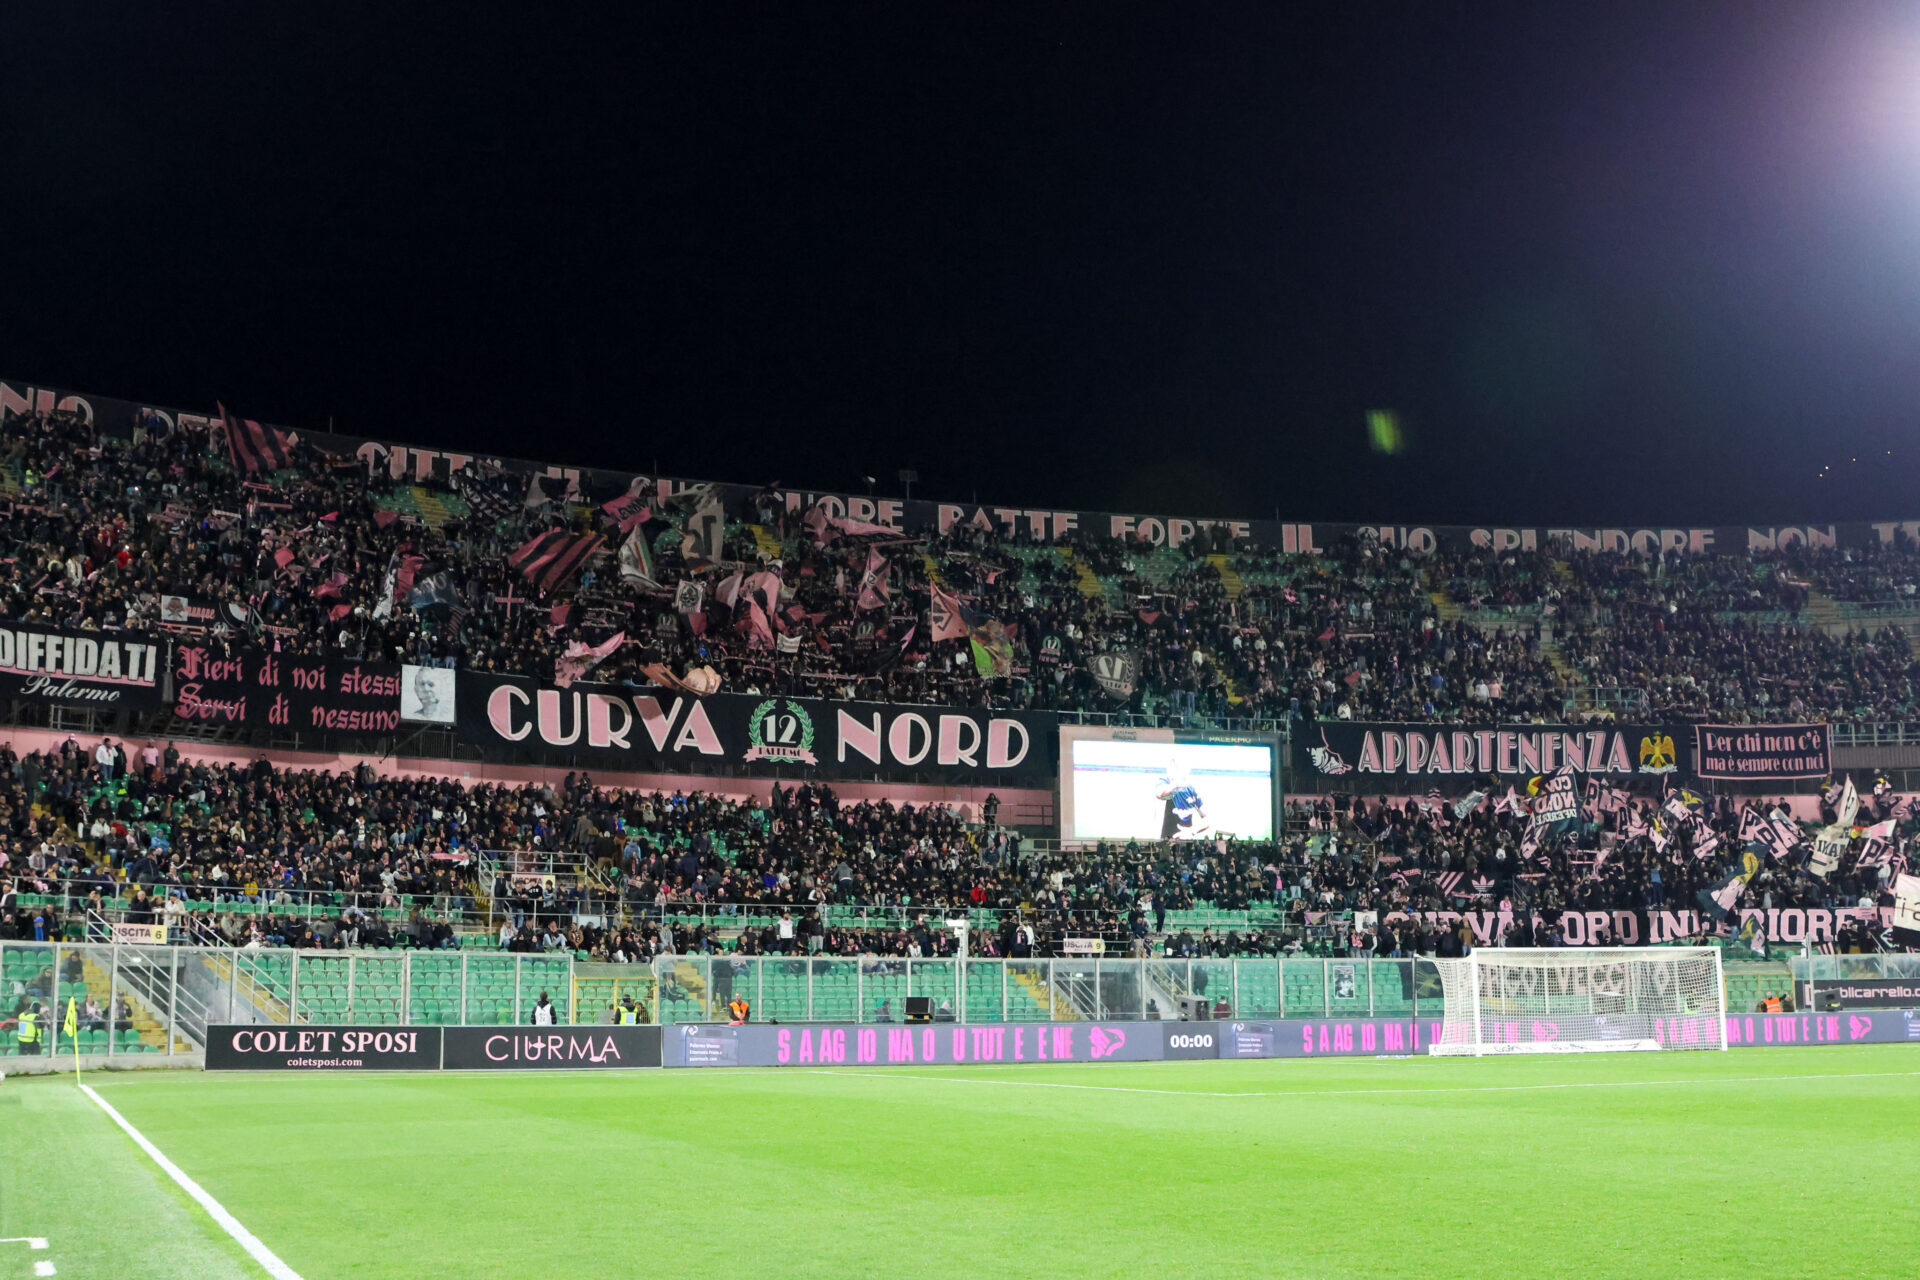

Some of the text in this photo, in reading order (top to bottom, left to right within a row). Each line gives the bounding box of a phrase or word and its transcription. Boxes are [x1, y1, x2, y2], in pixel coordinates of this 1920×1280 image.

[1282, 524, 1323, 554] IL
[20, 673, 121, 702] Palermo
[259, 654, 280, 687] di
[292, 665, 327, 691] noi
[340, 666, 400, 696] stessi
[174, 682, 400, 731] Servi di nessuno
[487, 684, 1030, 768] CURVA NORD
[763, 714, 798, 744] 12
[1358, 730, 1632, 774] APPARTENENZA
[1705, 732, 1734, 751] Per
[1737, 732, 1761, 752] chi
[1764, 735, 1796, 752] non
[1706, 753, 1825, 772] ma è sempre con noi
[155, 930, 162, 939] 6
[232, 1031, 417, 1054] COLET SPOSI
[485, 1034, 621, 1062] CIURMA
[1170, 1034, 1213, 1049] 00:00
[286, 1056, 362, 1068] coletsposi.com
